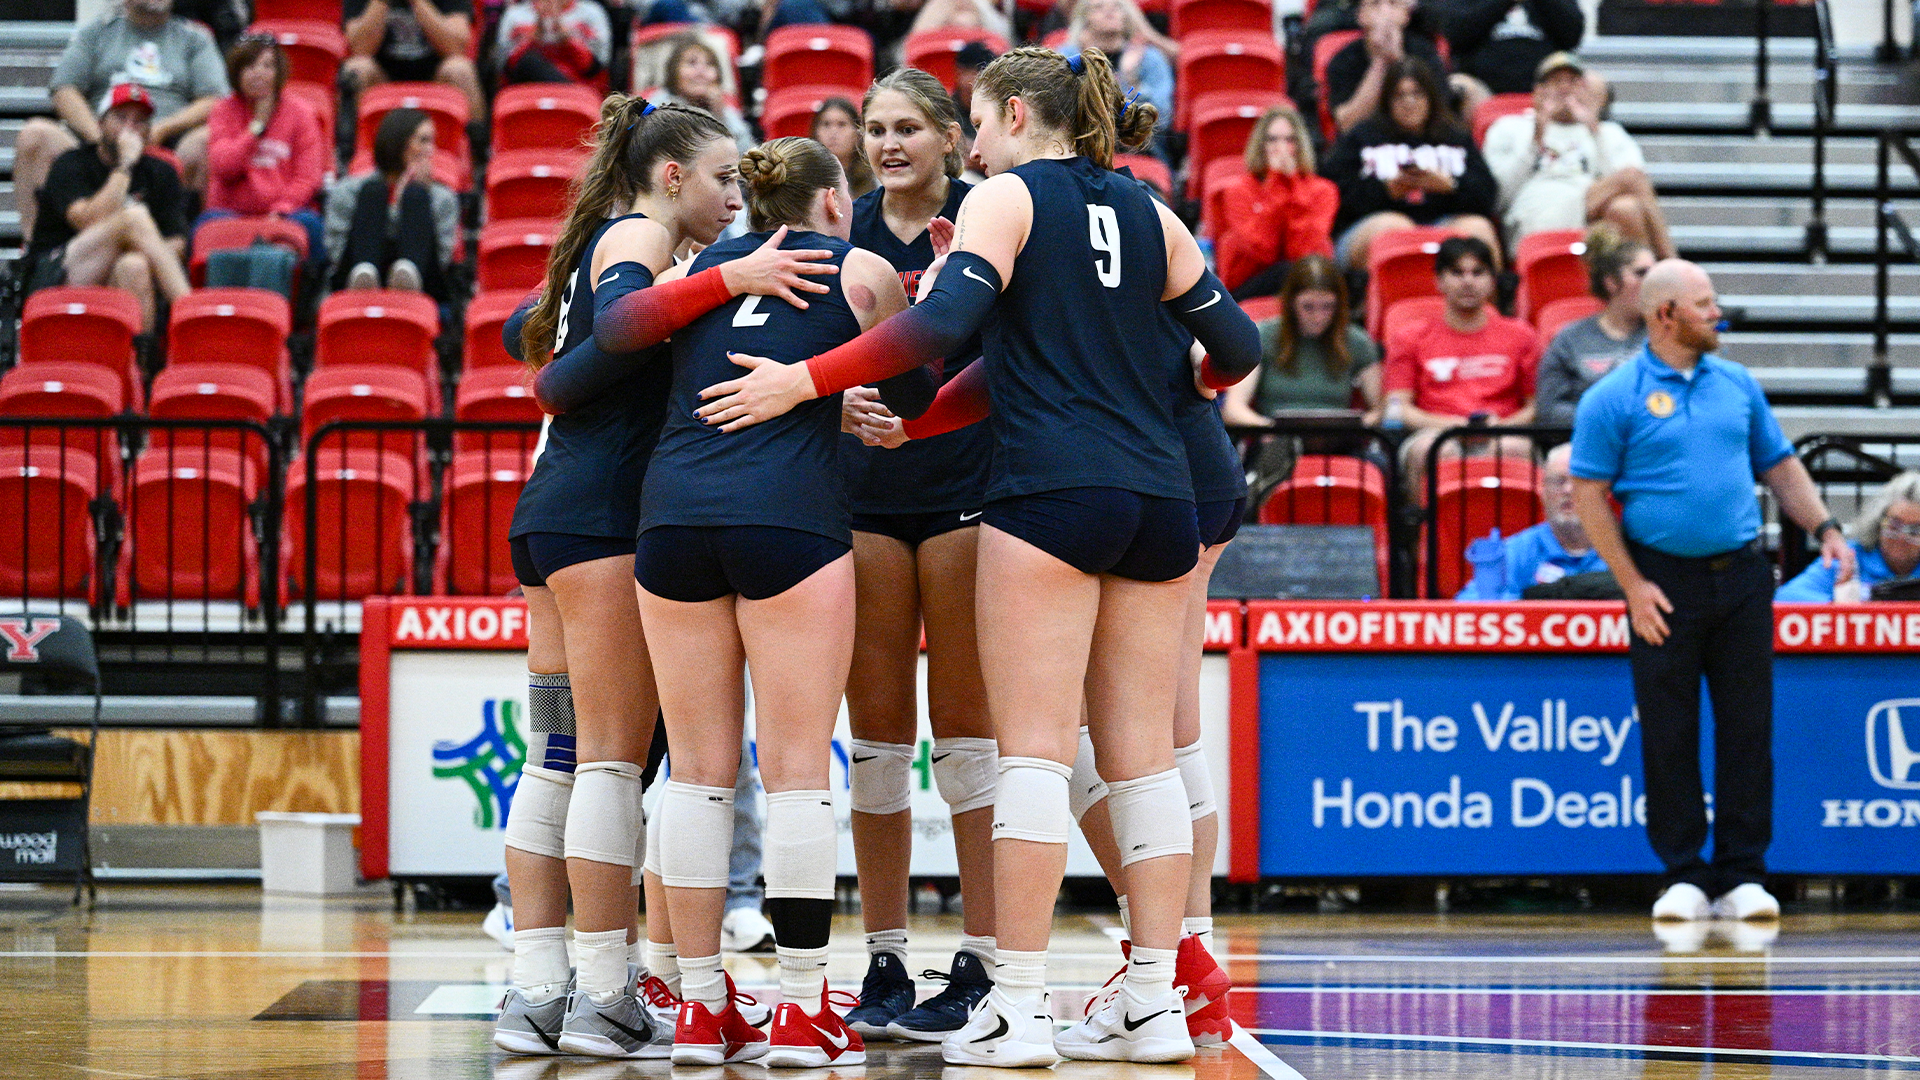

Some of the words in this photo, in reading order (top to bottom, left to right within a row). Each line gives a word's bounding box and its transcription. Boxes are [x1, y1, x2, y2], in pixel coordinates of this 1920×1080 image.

[1086, 203, 1121, 288] 9
[1257, 611, 1631, 647] AXIOFITNESS.COM
[1352, 698, 1459, 752] The
[1312, 774, 1493, 829] Honda
[1511, 774, 1715, 829] Deal
